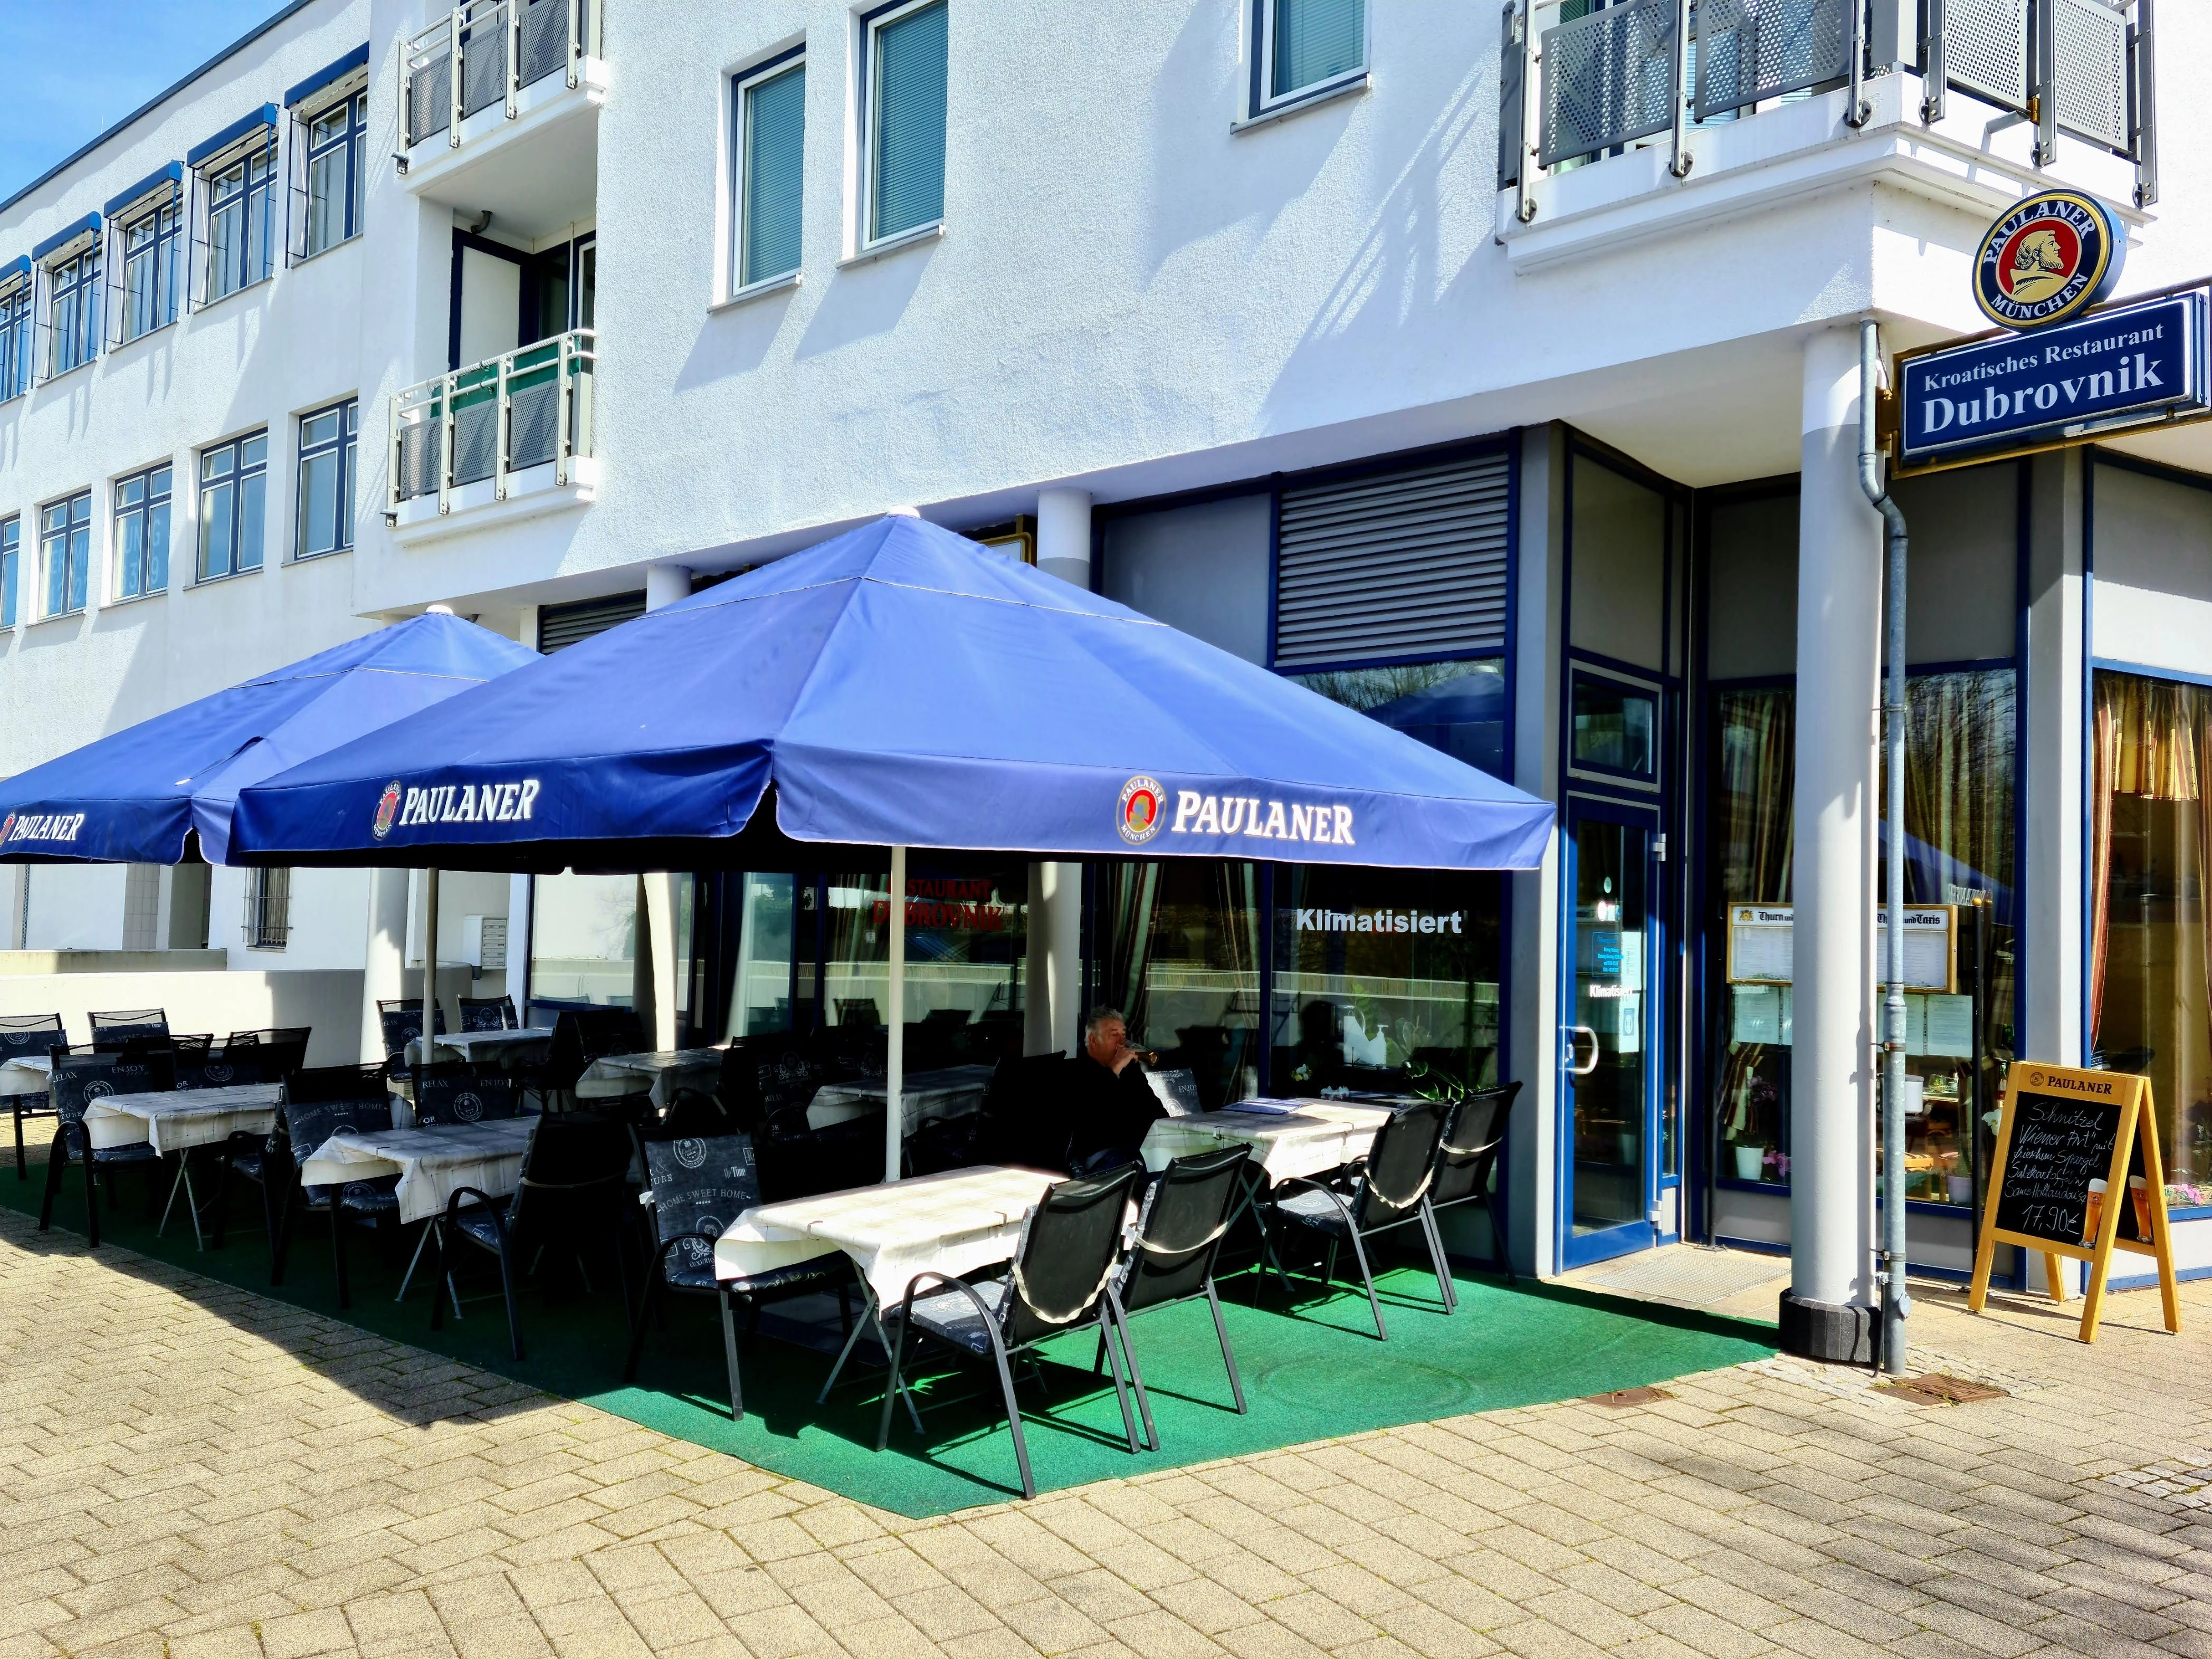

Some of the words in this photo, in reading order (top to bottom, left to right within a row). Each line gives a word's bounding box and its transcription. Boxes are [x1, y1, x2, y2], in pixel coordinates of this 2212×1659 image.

[1983, 201, 2096, 264] PAULANER
[1991, 272, 2088, 318] MÜNCHEN
[1924, 355, 2038, 392] Kroatisches
[2044, 322, 2164, 364] Restaurant
[1921, 352, 2165, 434] Dubrovnik
[398, 779, 539, 825] PAULANER
[1122, 779, 1164, 805] PAULANER
[7, 813, 84, 842] PAULANER
[1171, 790, 1356, 845] PAULANER
[888, 878, 993, 902] STAURANT
[873, 900, 1005, 931] DBROVNIK
[1296, 909, 1462, 933] Klimatisiert
[1759, 911, 1784, 921] Thurn
[53, 1071, 78, 1082] ELAX
[112, 1064, 145, 1073] ENJOY
[423, 1080, 449, 1089] RELAX
[2047, 1076, 2113, 1095] PAULANER
[298, 1108, 322, 1123] HOME
[2028, 1102, 2103, 1130] Schnitzel
[651, 1174, 673, 1186] URE
[659, 1194, 685, 1212] HOME
[687, 1189, 717, 1200] SWEET
[720, 1189, 747, 1199] HOME
[689, 1257, 715, 1267] LUXURIO
